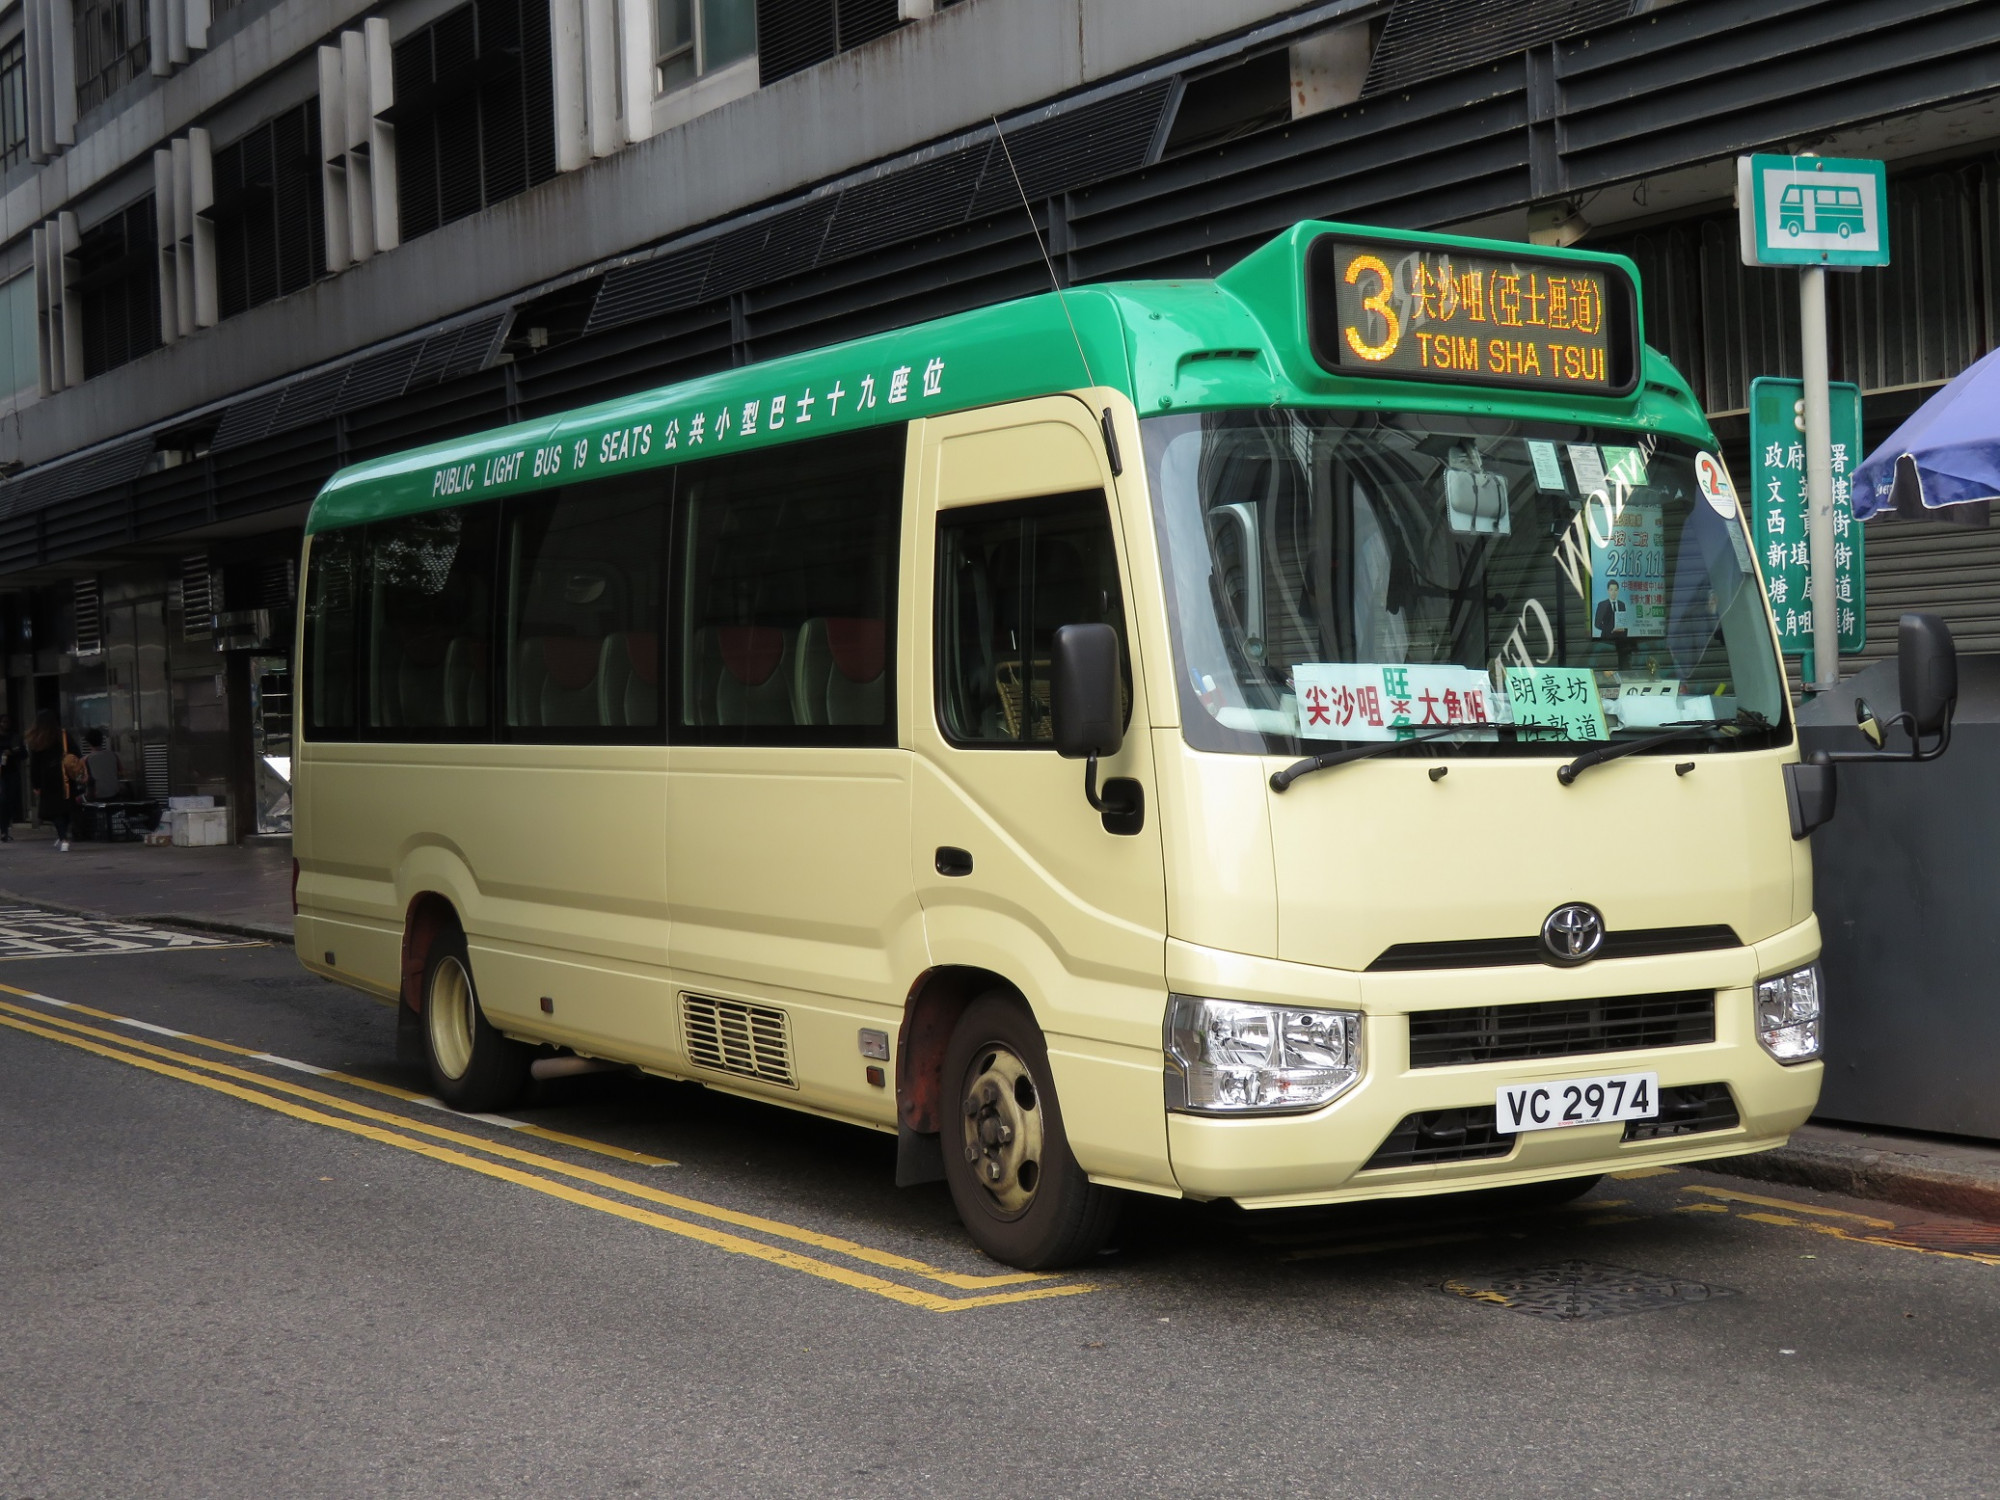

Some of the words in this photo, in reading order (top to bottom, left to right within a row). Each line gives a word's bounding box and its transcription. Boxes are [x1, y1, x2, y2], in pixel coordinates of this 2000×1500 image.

[1344, 254, 1401, 362] 3
[1416, 332, 1479, 371] TSIM
[1488, 340, 1541, 376] SHA
[1548, 344, 1604, 382] TSUI
[432, 461, 476, 498] PUBLIC
[484, 451, 525, 488] LIGHT
[533, 445, 561, 479] BUS
[573, 438, 588, 470] 19
[600, 424, 653, 464] SEATS
[664, 357, 946, 451] 公共小型巴士十九座位
[1764, 441, 1849, 473] 政府署
[1767, 541, 1852, 571] 新填街
[1305, 685, 1384, 727] 尖沙咀
[1418, 687, 1487, 725] 大角咀
[1510, 674, 1588, 706] 朗豪坊
[1507, 1088, 1550, 1126] VC
[1562, 1079, 1649, 1121] 2974
